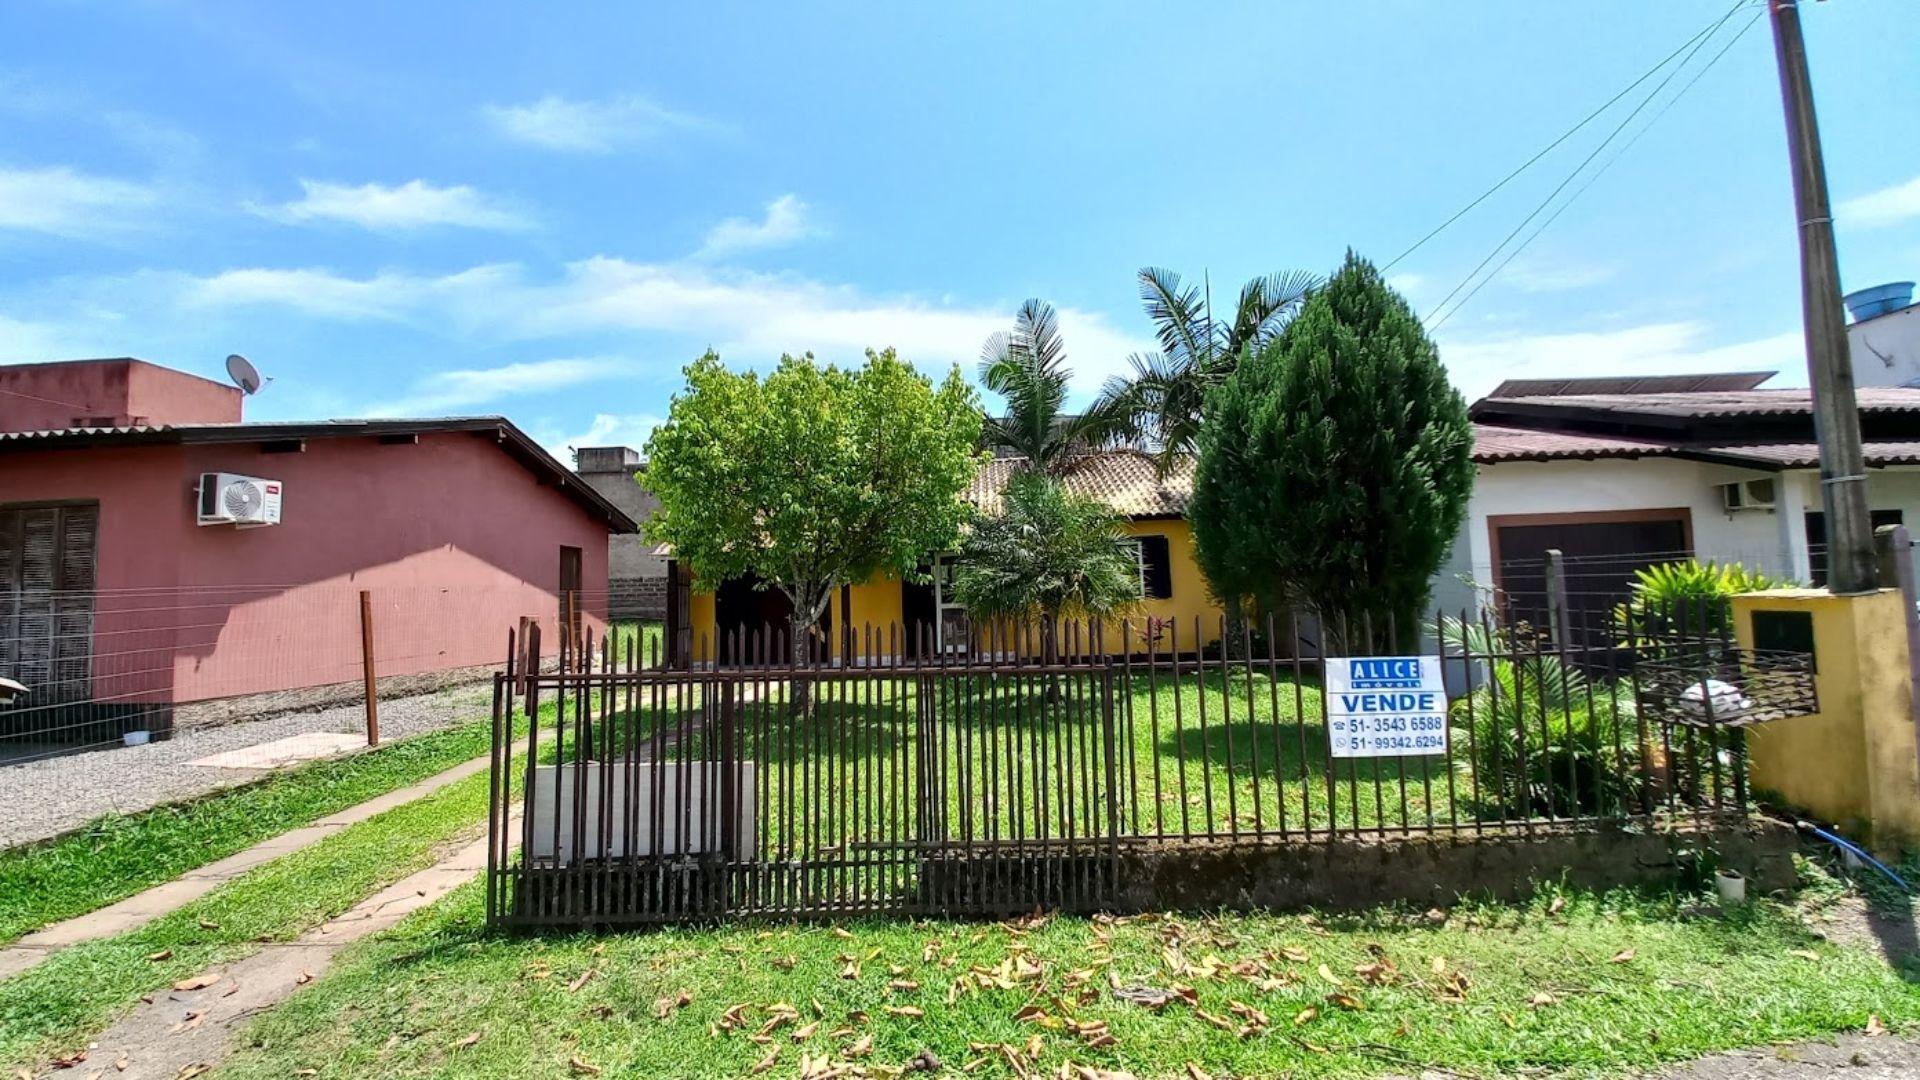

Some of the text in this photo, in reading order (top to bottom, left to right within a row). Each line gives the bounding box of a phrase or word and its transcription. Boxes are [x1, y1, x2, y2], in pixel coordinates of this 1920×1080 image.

[1354, 661, 1418, 678] ALICE
[1342, 694, 1434, 712] VENDE
[1374, 718, 1406, 731] 3543
[1411, 716, 1442, 731] 6588
[1375, 735, 1444, 749] 99342.6294
